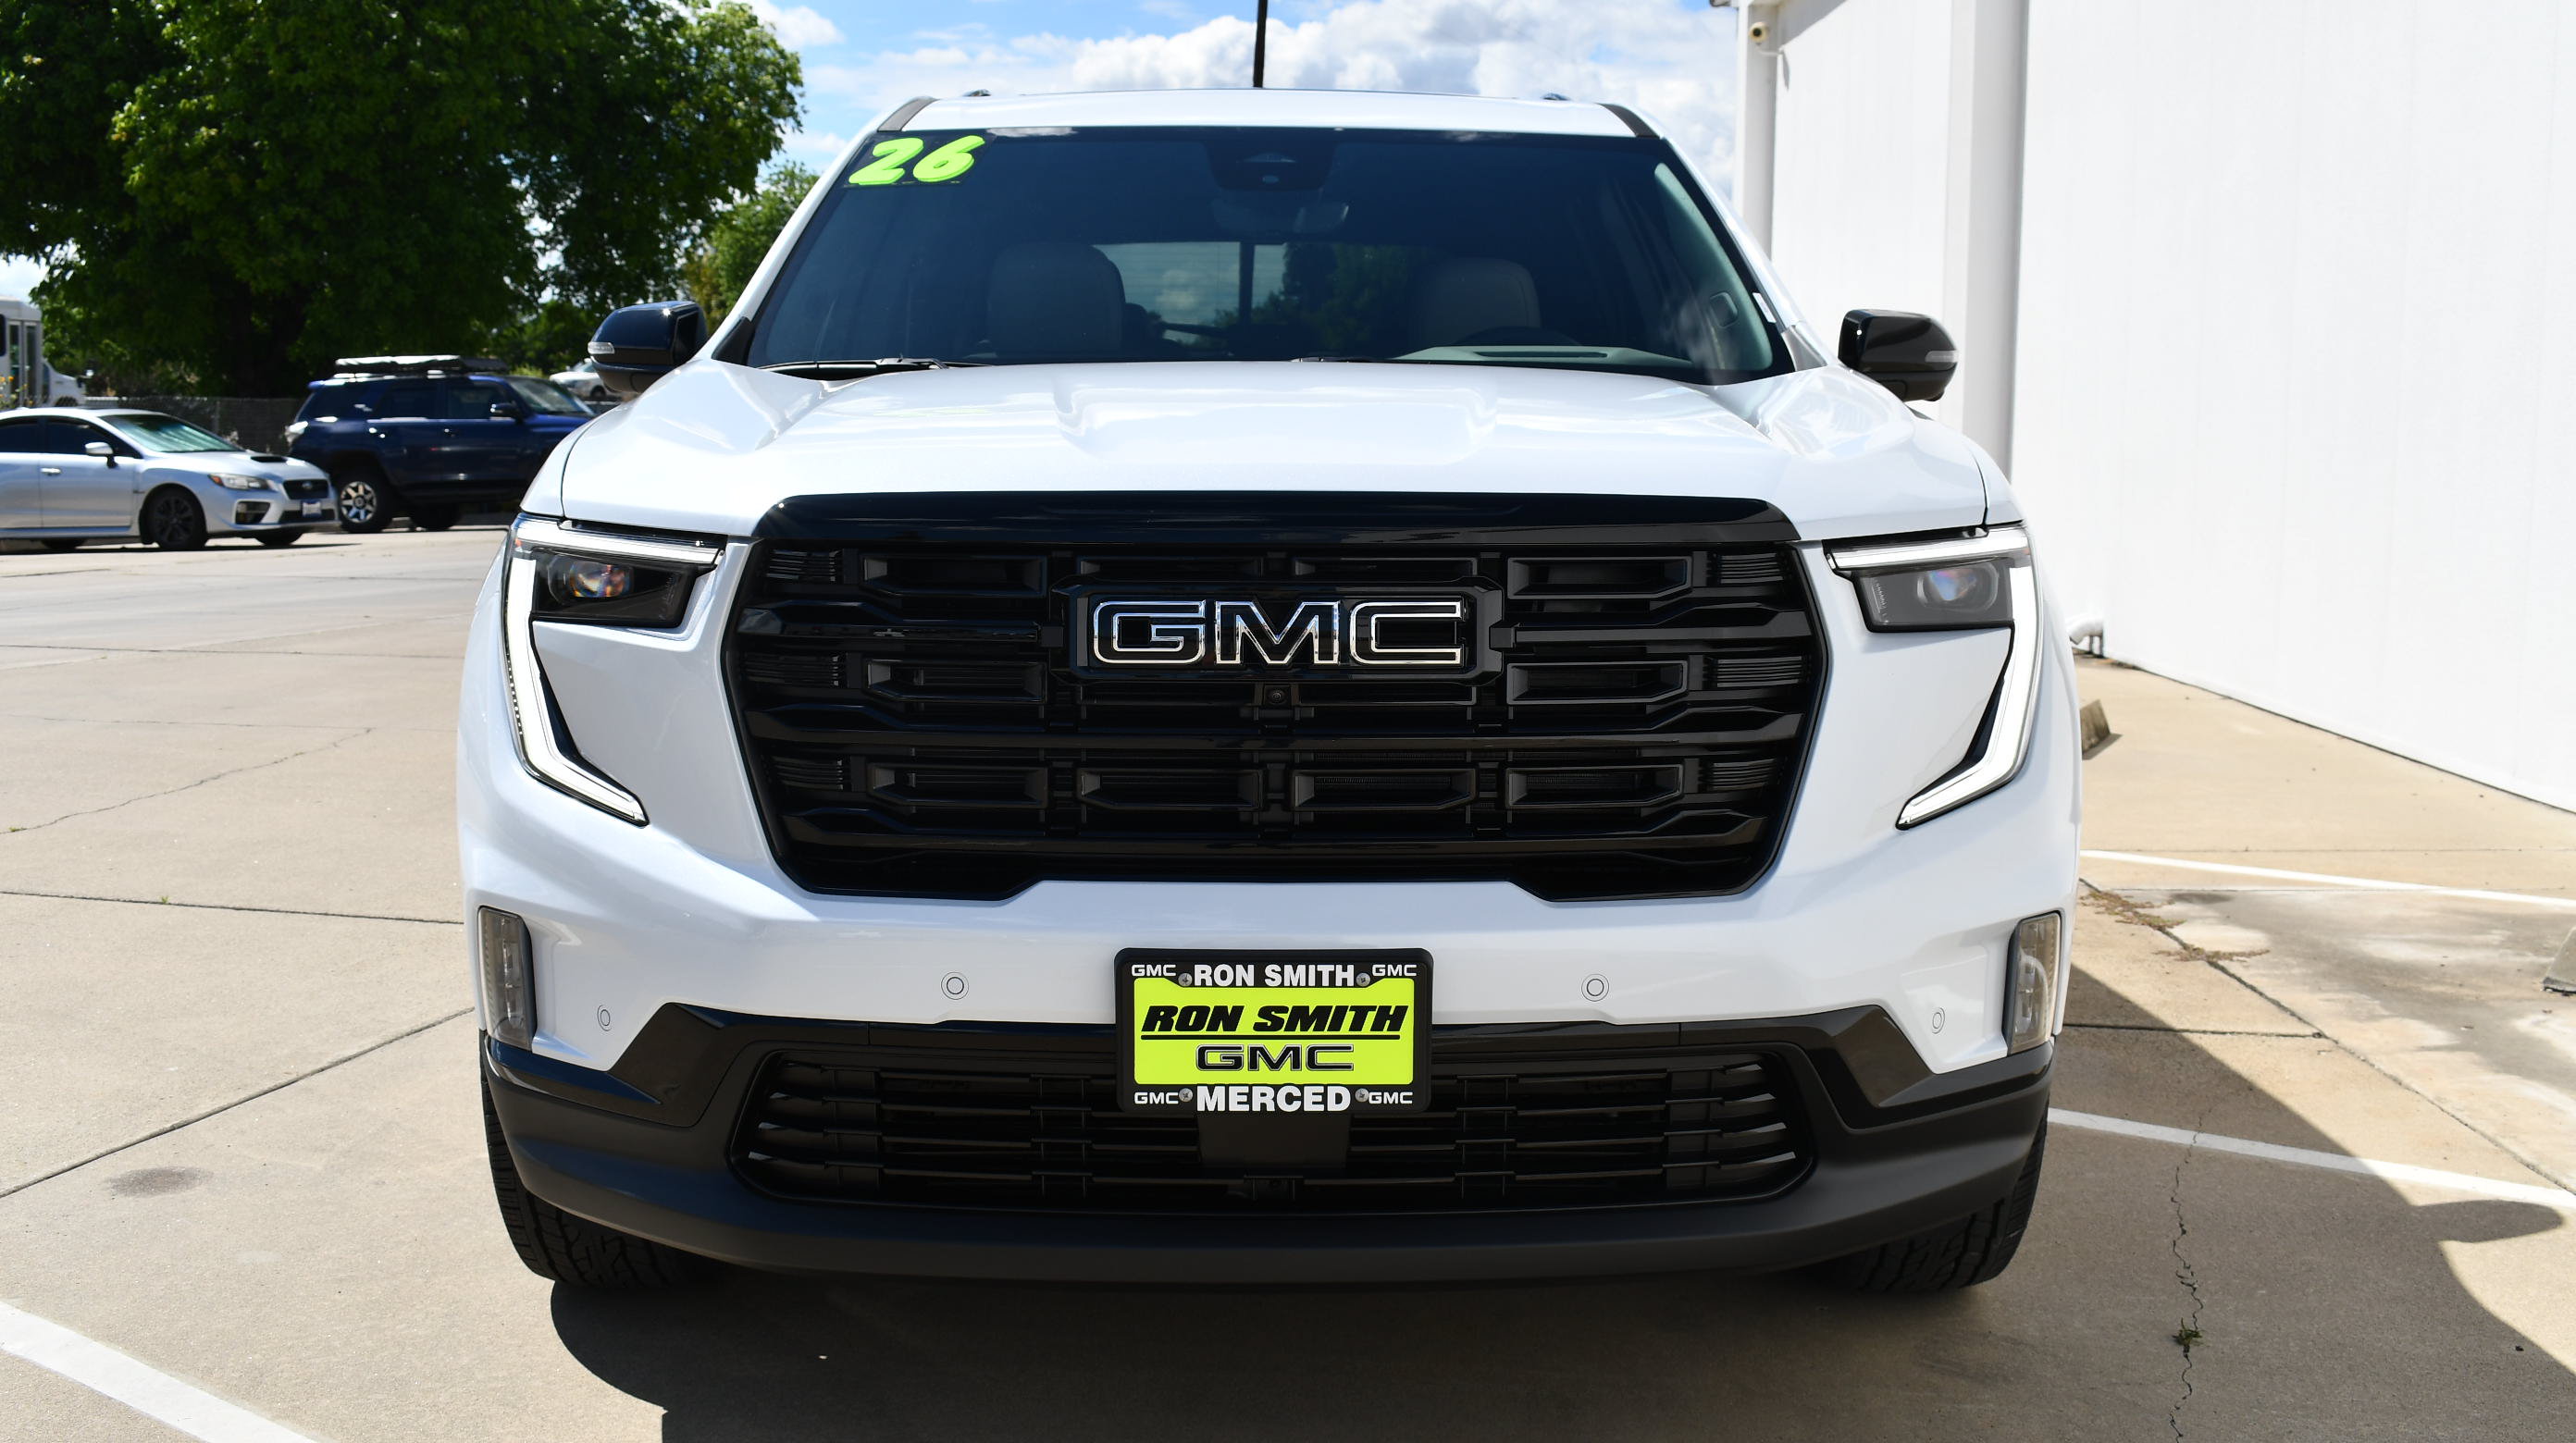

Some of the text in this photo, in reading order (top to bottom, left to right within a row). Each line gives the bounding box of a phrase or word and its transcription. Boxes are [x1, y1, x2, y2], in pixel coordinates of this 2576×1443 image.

[848, 135, 985, 185] 26
[1093, 599, 1464, 665] GMC
[1131, 964, 1176, 977] GMC
[1195, 964, 1355, 987] RON SMITH
[1372, 964, 1418, 977] GMC
[1141, 1005, 1409, 1032] RON SMITH
[1195, 1044, 1354, 1072] GMC
[1133, 1092, 1179, 1104] GMC
[1196, 1085, 1351, 1112] MERCED
[1368, 1092, 1413, 1104] GMC
